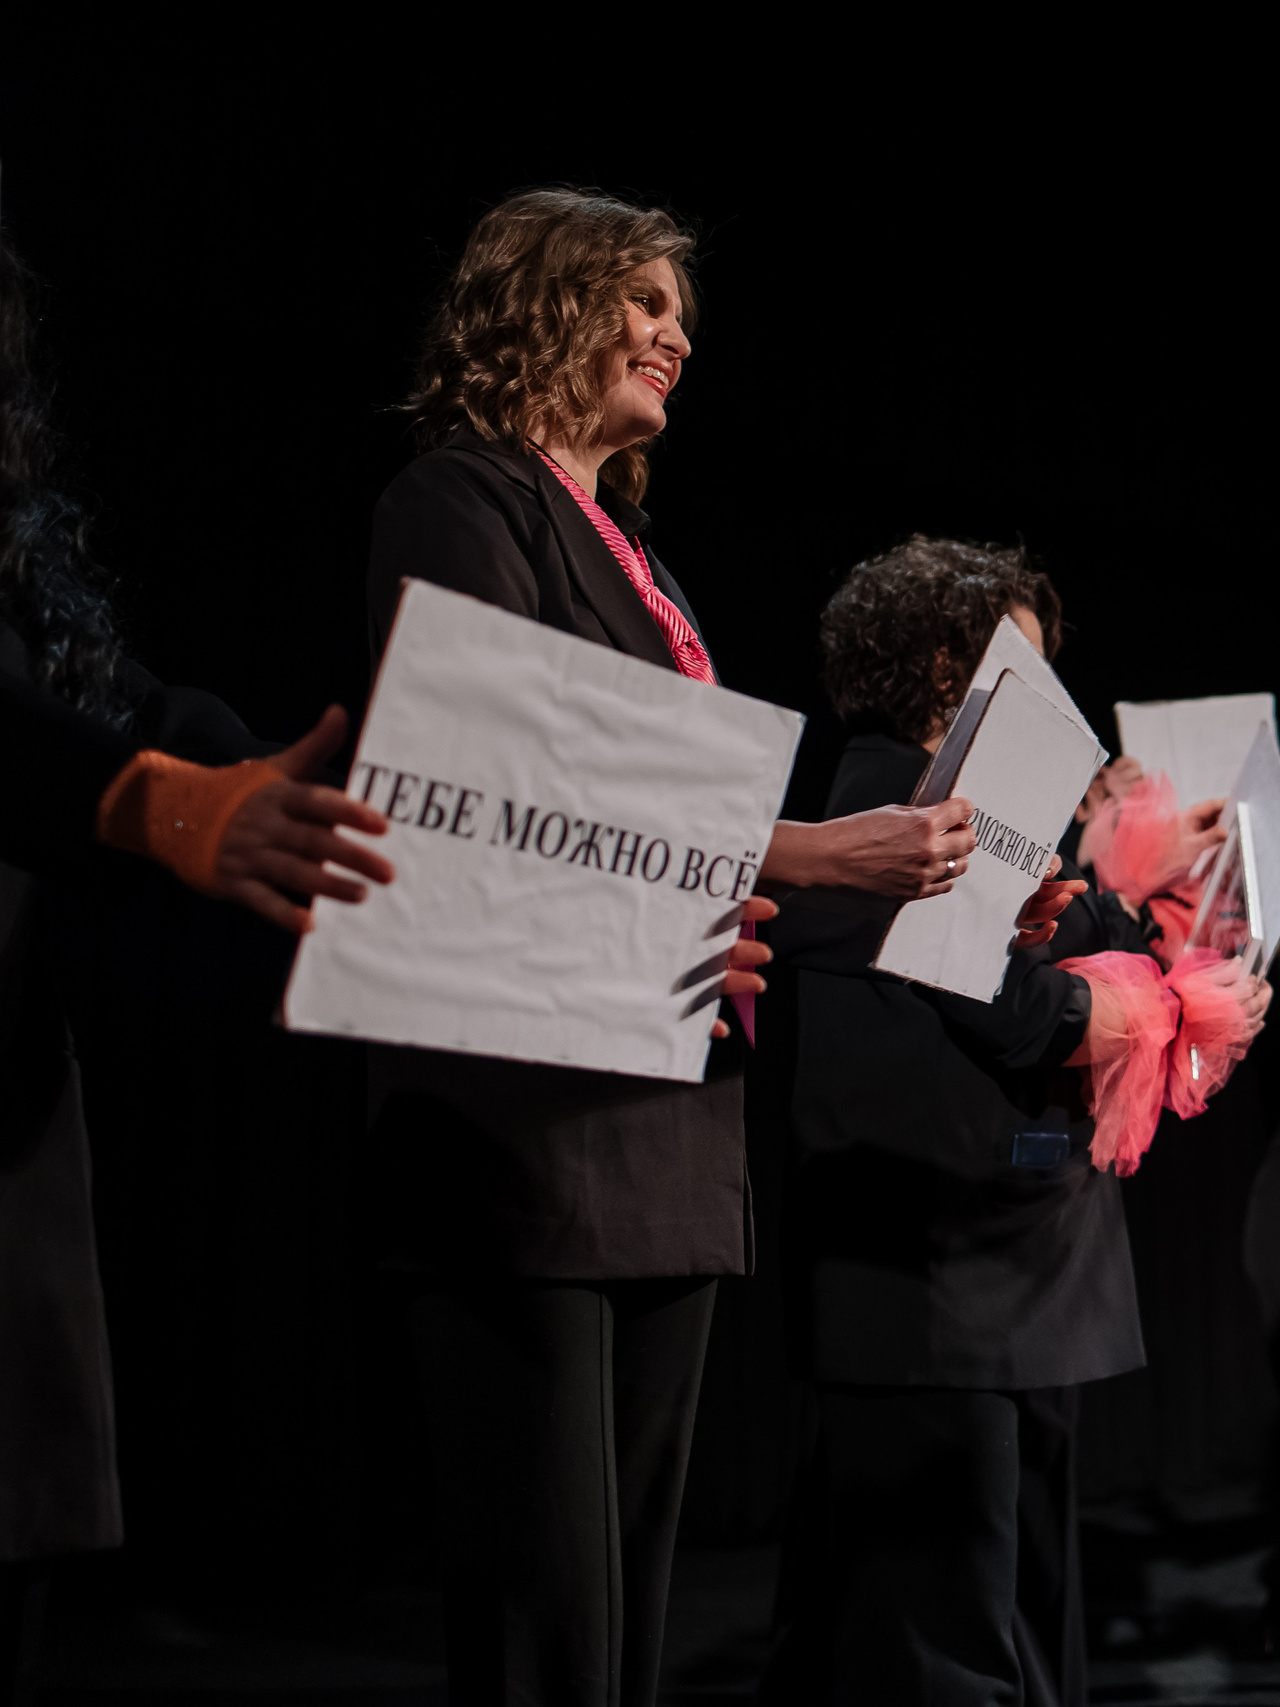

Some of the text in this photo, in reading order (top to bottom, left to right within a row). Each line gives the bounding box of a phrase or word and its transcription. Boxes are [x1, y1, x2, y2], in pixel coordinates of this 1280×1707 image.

[357, 762, 758, 901] ТЕБЕ МОЖНО ВСЁ
[1019, 841, 1052, 879] ВСЁ
